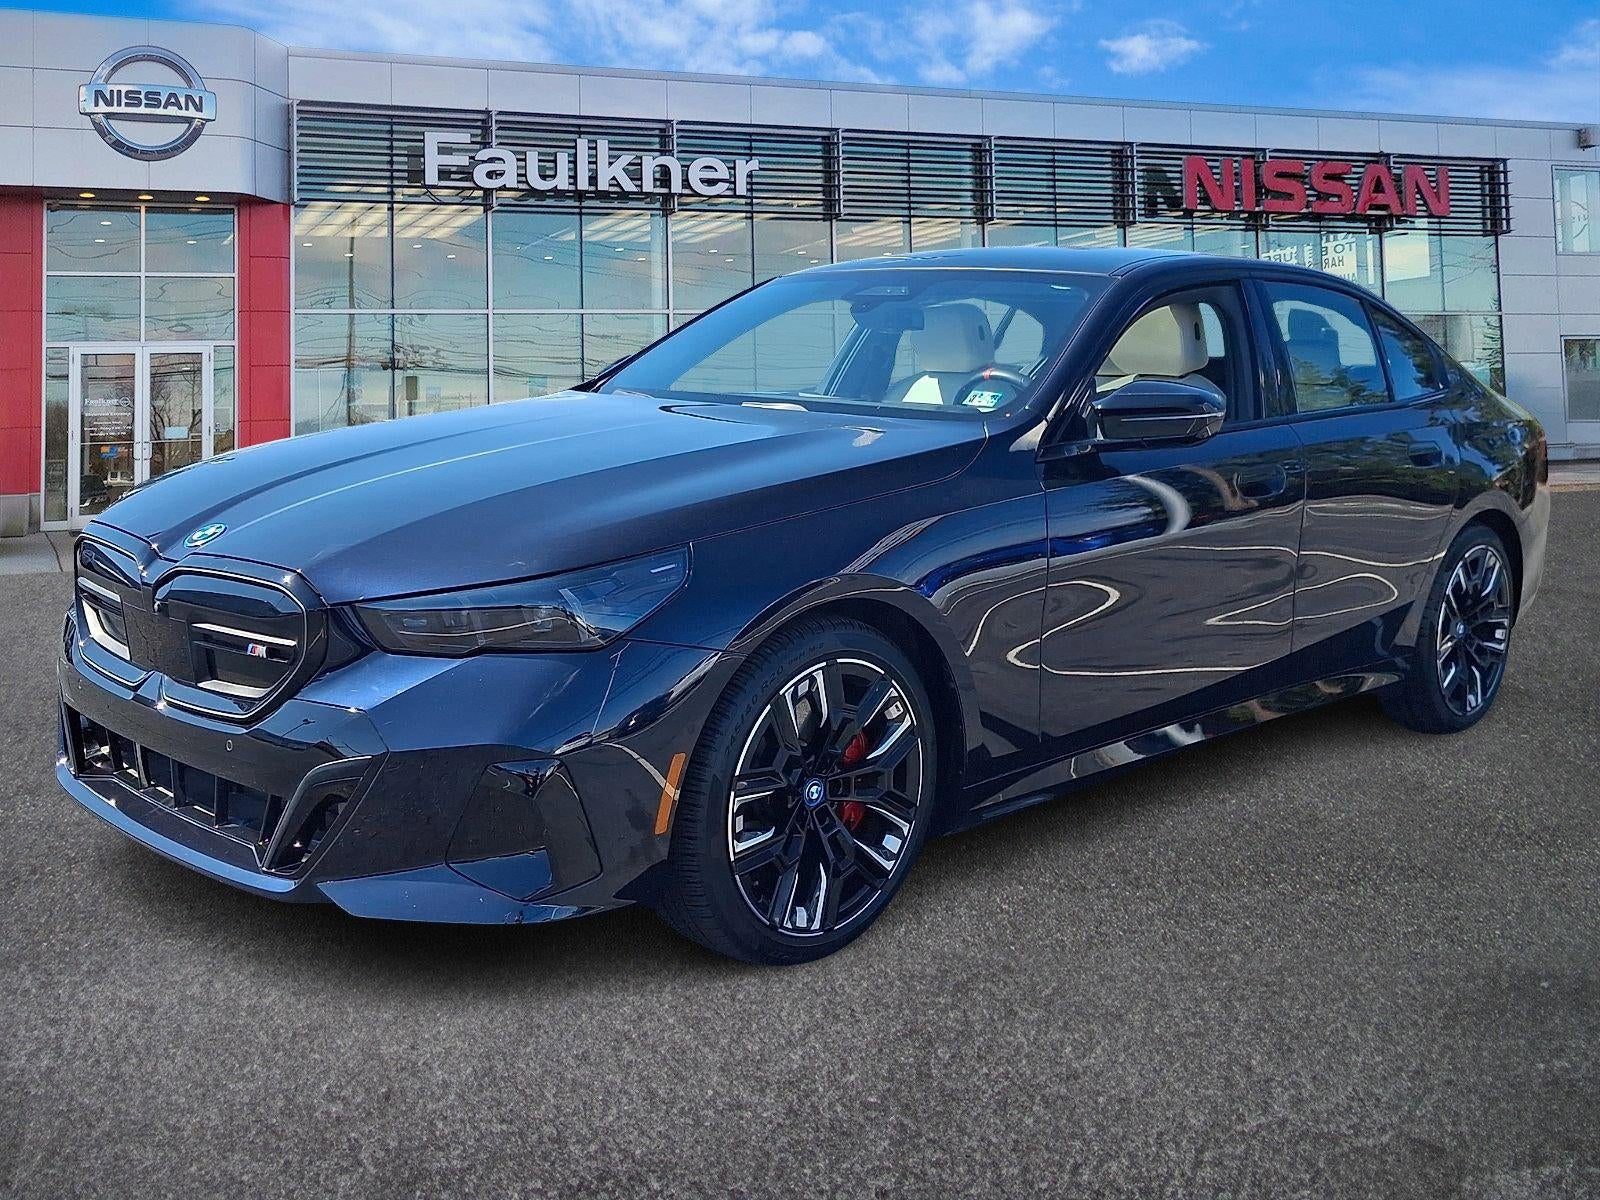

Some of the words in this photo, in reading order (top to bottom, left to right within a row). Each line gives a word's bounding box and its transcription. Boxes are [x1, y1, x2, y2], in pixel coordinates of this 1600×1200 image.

[93, 89, 203, 113] NISSAN
[423, 131, 760, 197] Faulkner
[1182, 155, 1450, 216] NISSAN
